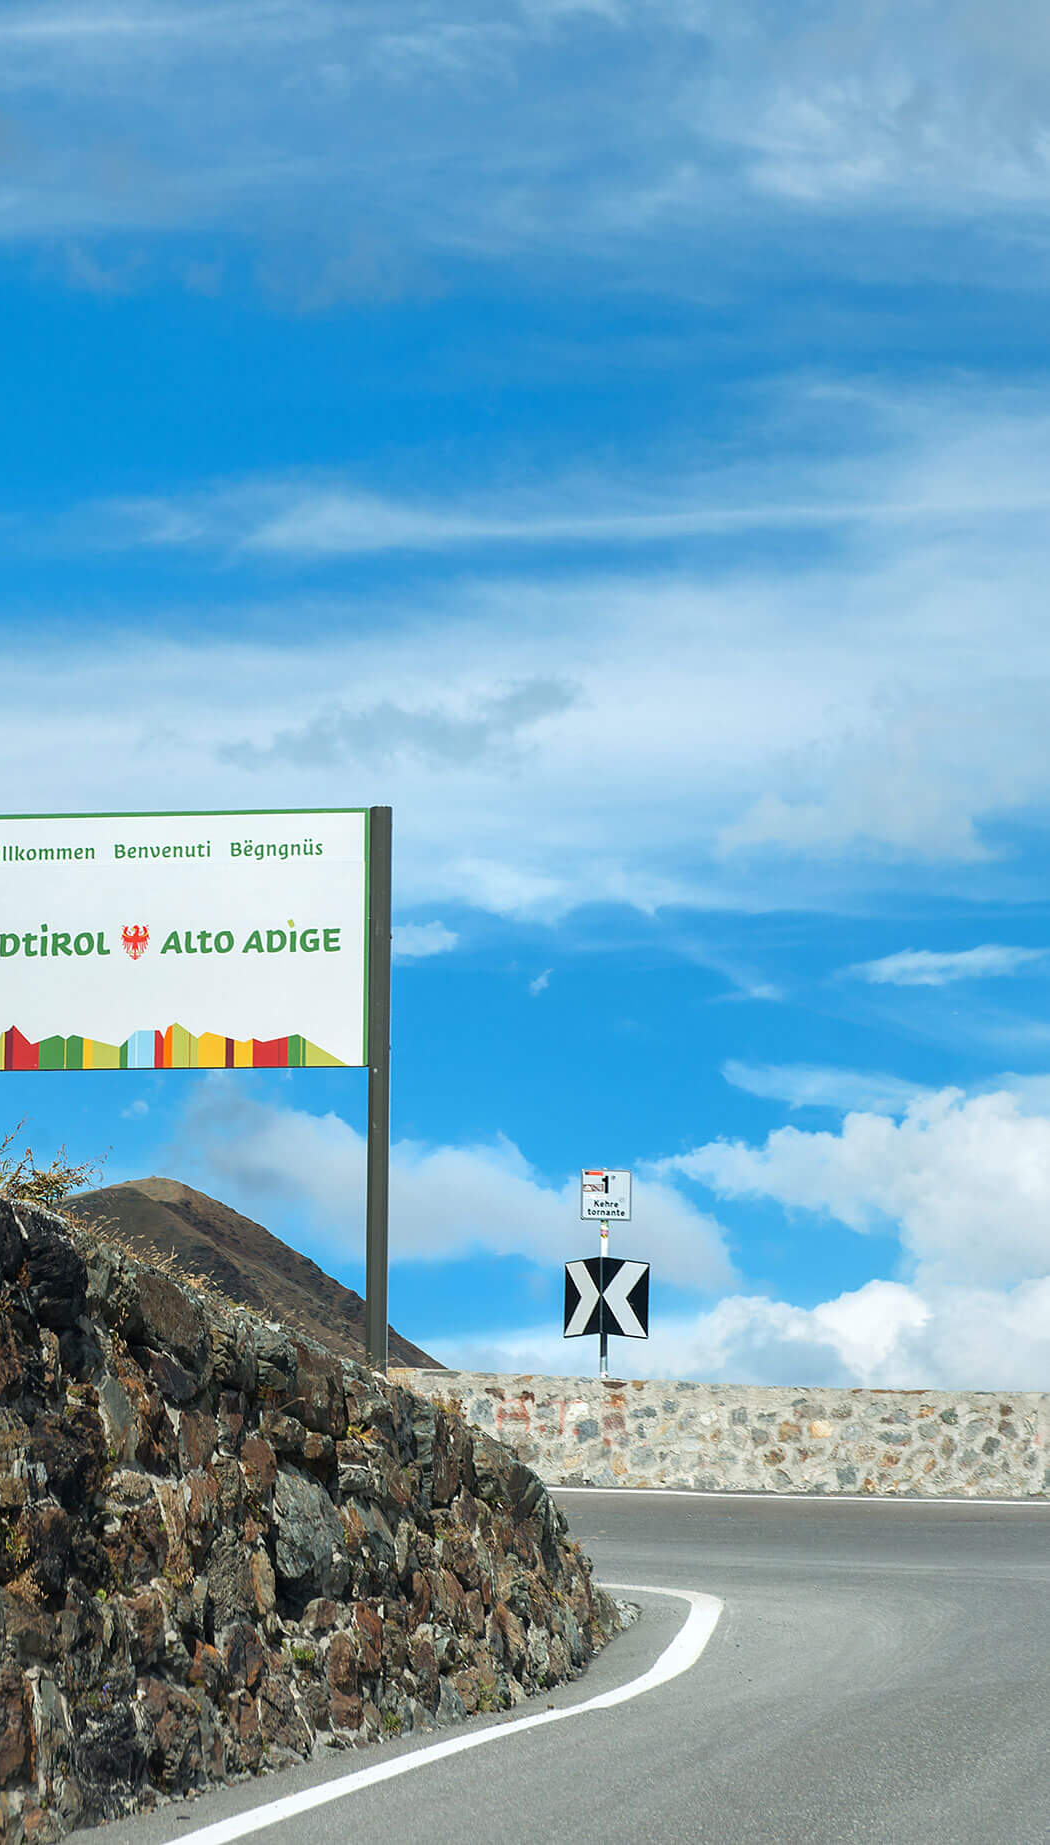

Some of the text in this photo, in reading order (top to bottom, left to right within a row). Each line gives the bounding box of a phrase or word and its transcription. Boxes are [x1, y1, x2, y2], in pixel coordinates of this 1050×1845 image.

[114, 840, 211, 859] Benvenuti
[230, 838, 323, 861] Bëgngnüs
[593, 1200, 619, 1208] Kehre
[587, 1208, 626, 1217] tornante
